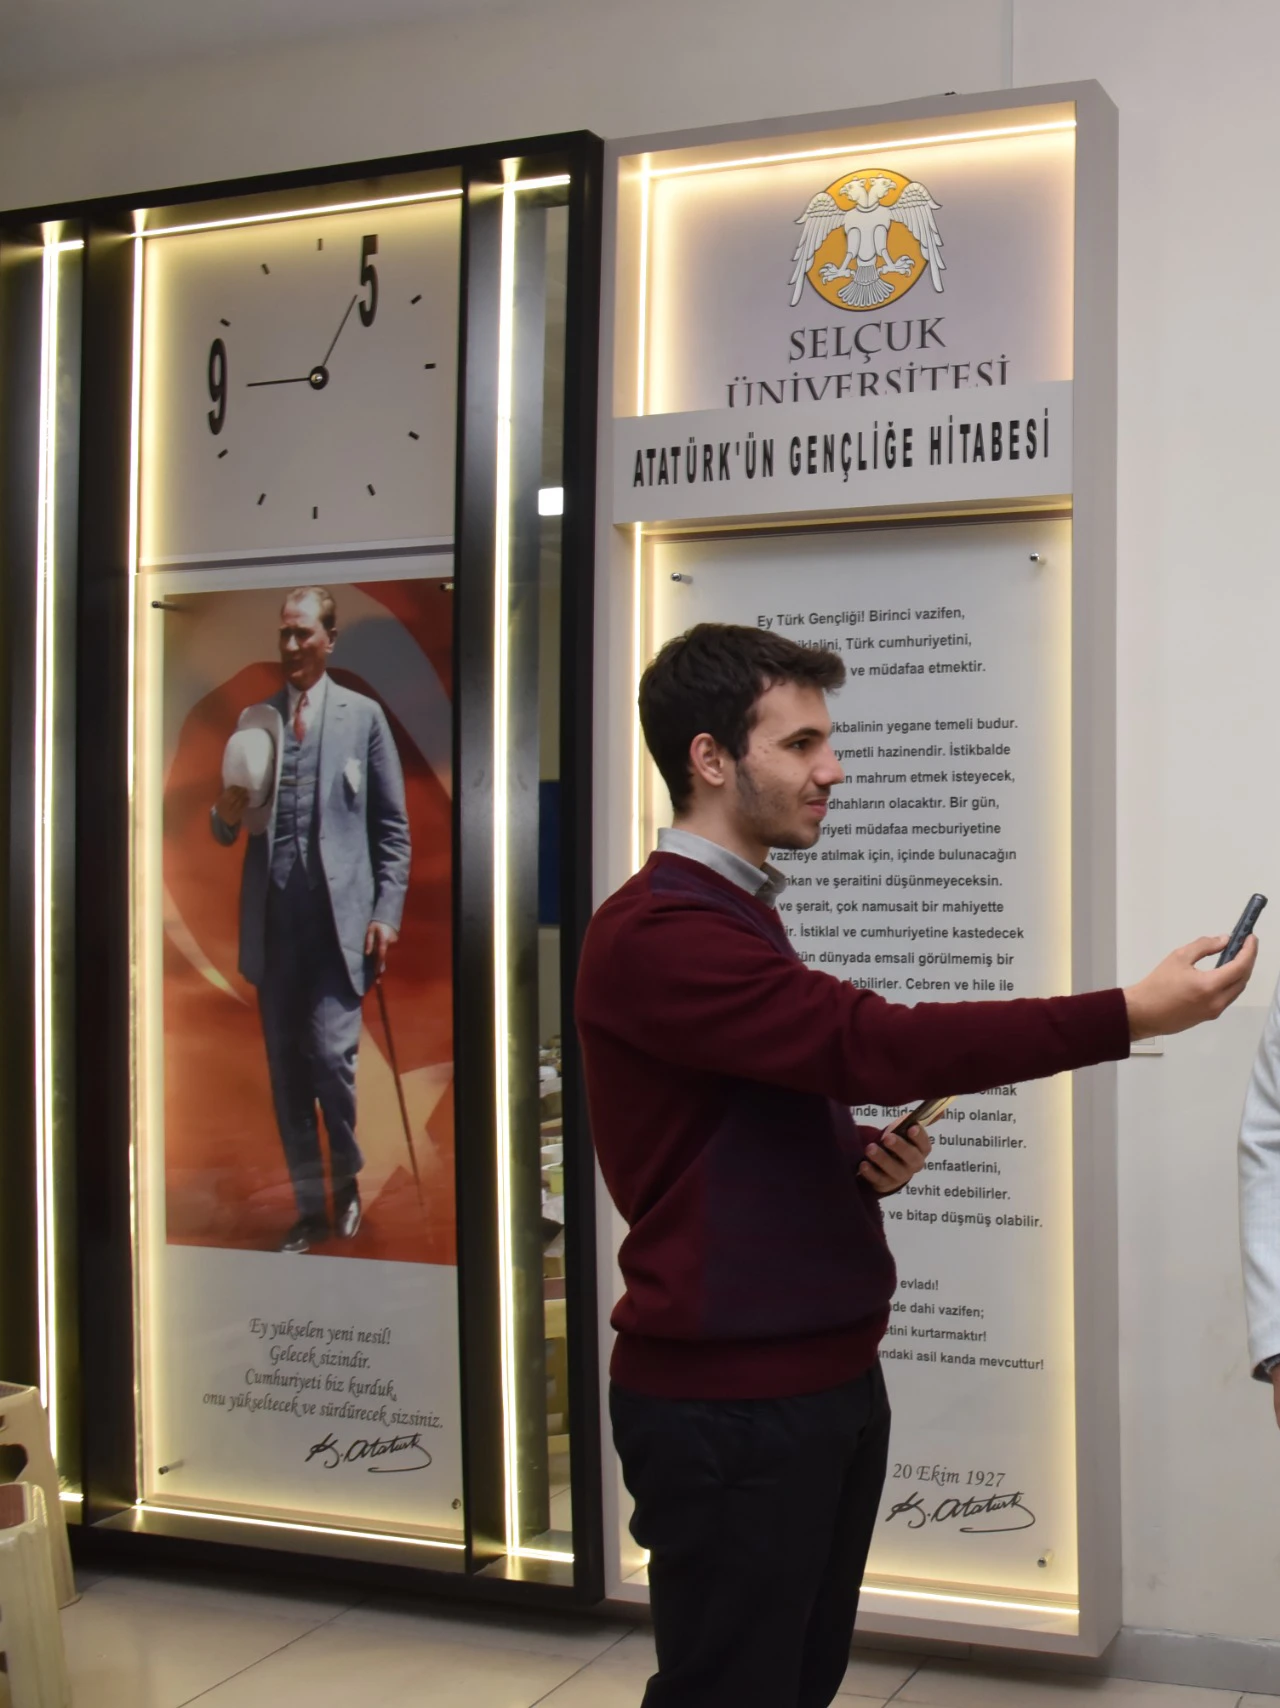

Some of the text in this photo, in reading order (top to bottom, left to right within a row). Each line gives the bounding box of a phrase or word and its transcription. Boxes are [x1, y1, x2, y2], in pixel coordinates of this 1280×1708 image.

[358, 235, 378, 327] 5
[789, 318, 945, 366] SELÇUK
[208, 338, 227, 435] 9
[633, 408, 1048, 487] ATATÜRK'ÜN GENÇLİĞE HİTABESİ
[758, 607, 964, 629] Ey Türk Gençliği! Birinci vazifen,
[846, 634, 971, 649] Türk cumhuriyetini,
[851, 660, 985, 676] ve müdafaa etmektir.
[887, 718, 1017, 734] yegane temeli budur.
[878, 744, 1010, 757] hazinendir. İstikbalde
[889, 796, 999, 810] olacaktır. Bir gün,
[856, 823, 1001, 836] müdafaa mecburiyetine
[821, 849, 1016, 863] atılmak için, içinde bulunacağın
[816, 875, 1003, 889] ve şeraitini düşünmeyeceksin.
[779, 900, 1003, 915] ve şerait, çok namusait bir mahiyette
[801, 923, 839, 937] İstiklal
[843, 929, 856, 937] ve
[861, 926, 948, 940] cumhuriyetine
[953, 927, 1024, 938] kastedecek
[819, 952, 871, 965] dünyada
[875, 952, 914, 963] emsali
[919, 953, 992, 967] görülmemiş
[997, 953, 1014, 965] bir
[969, 1110, 1016, 1123] olanlar,
[939, 1134, 1026, 1148] bulunabilirler.
[906, 1184, 941, 1197] tevhit
[944, 1186, 1010, 1199] edebilirler.
[889, 1211, 902, 1220] ve
[907, 1209, 937, 1224] bitap
[941, 1211, 991, 1227] düşmüş
[995, 1214, 1042, 1227] olabilir.
[910, 1303, 934, 1314] dahi
[939, 1306, 983, 1319] vazifen;
[911, 1326, 986, 1341] kurtarmaktır!
[917, 1352, 936, 1362] asil
[941, 1352, 975, 1365] kanda
[980, 1358, 1043, 1369] mevcuttur!
[893, 1464, 1005, 1487] 20 Ekim 1927
